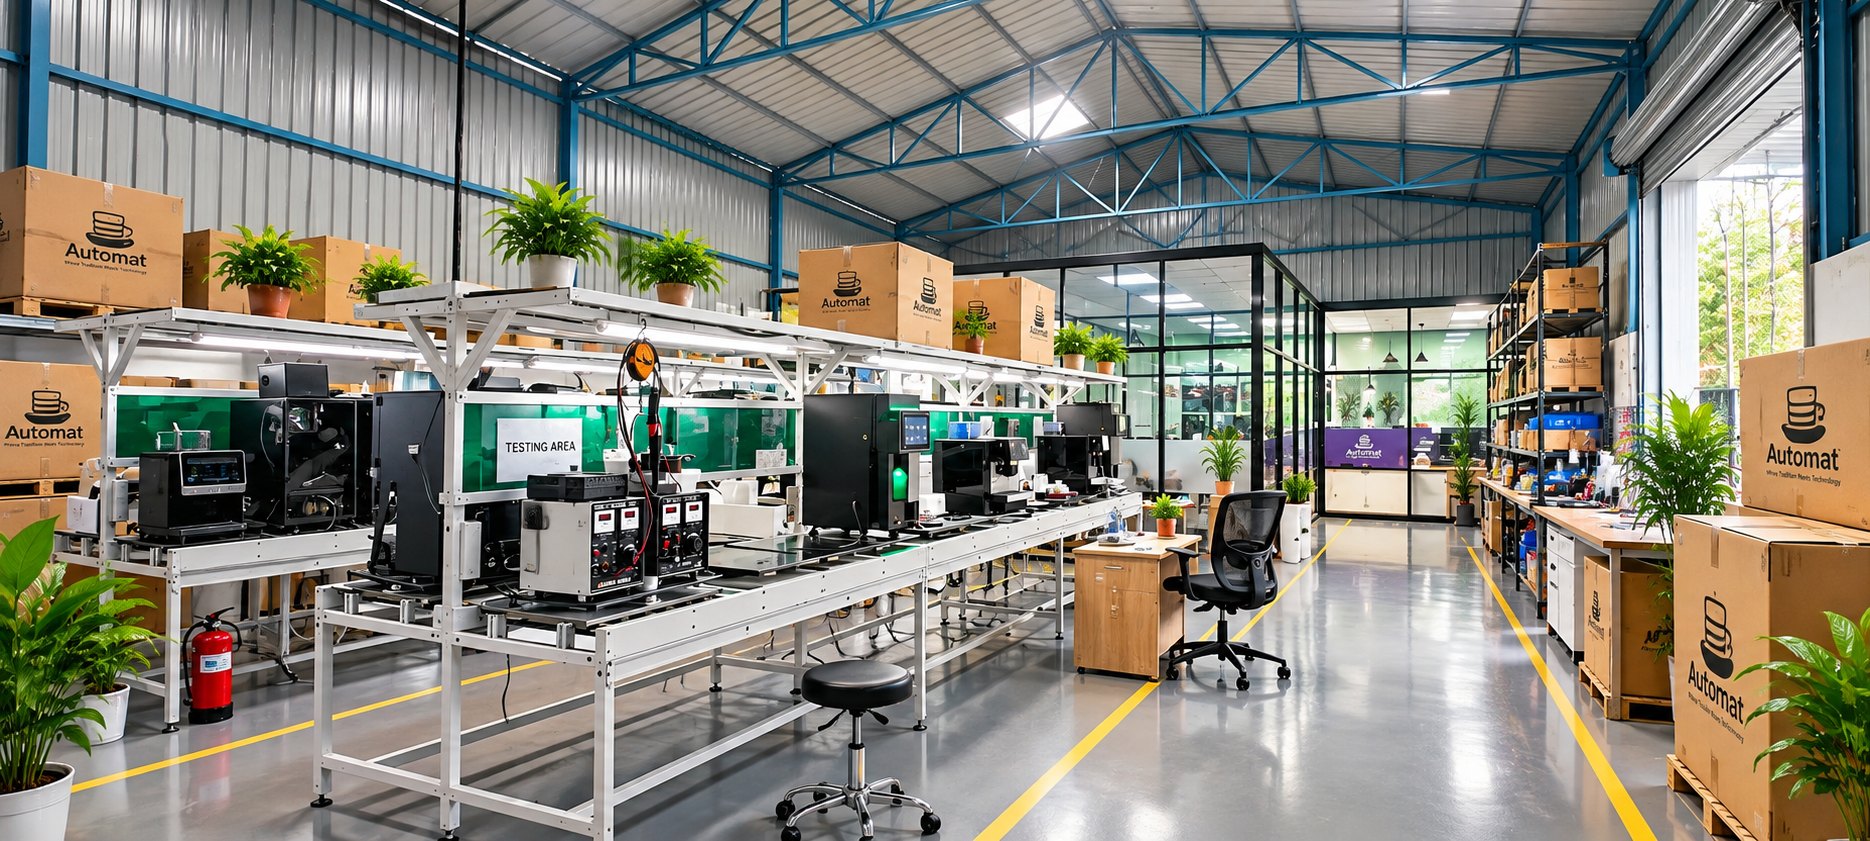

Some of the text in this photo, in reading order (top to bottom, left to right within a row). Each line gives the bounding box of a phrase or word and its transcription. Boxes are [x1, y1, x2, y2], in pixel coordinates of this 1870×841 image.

[64, 242, 147, 267] Automat
[821, 296, 871, 309] Automat
[4, 425, 84, 440] Automat
[505, 440, 576, 453] TESTING AREA
[1766, 442, 1839, 472] Automat
[1687, 659, 1744, 725] Automat
